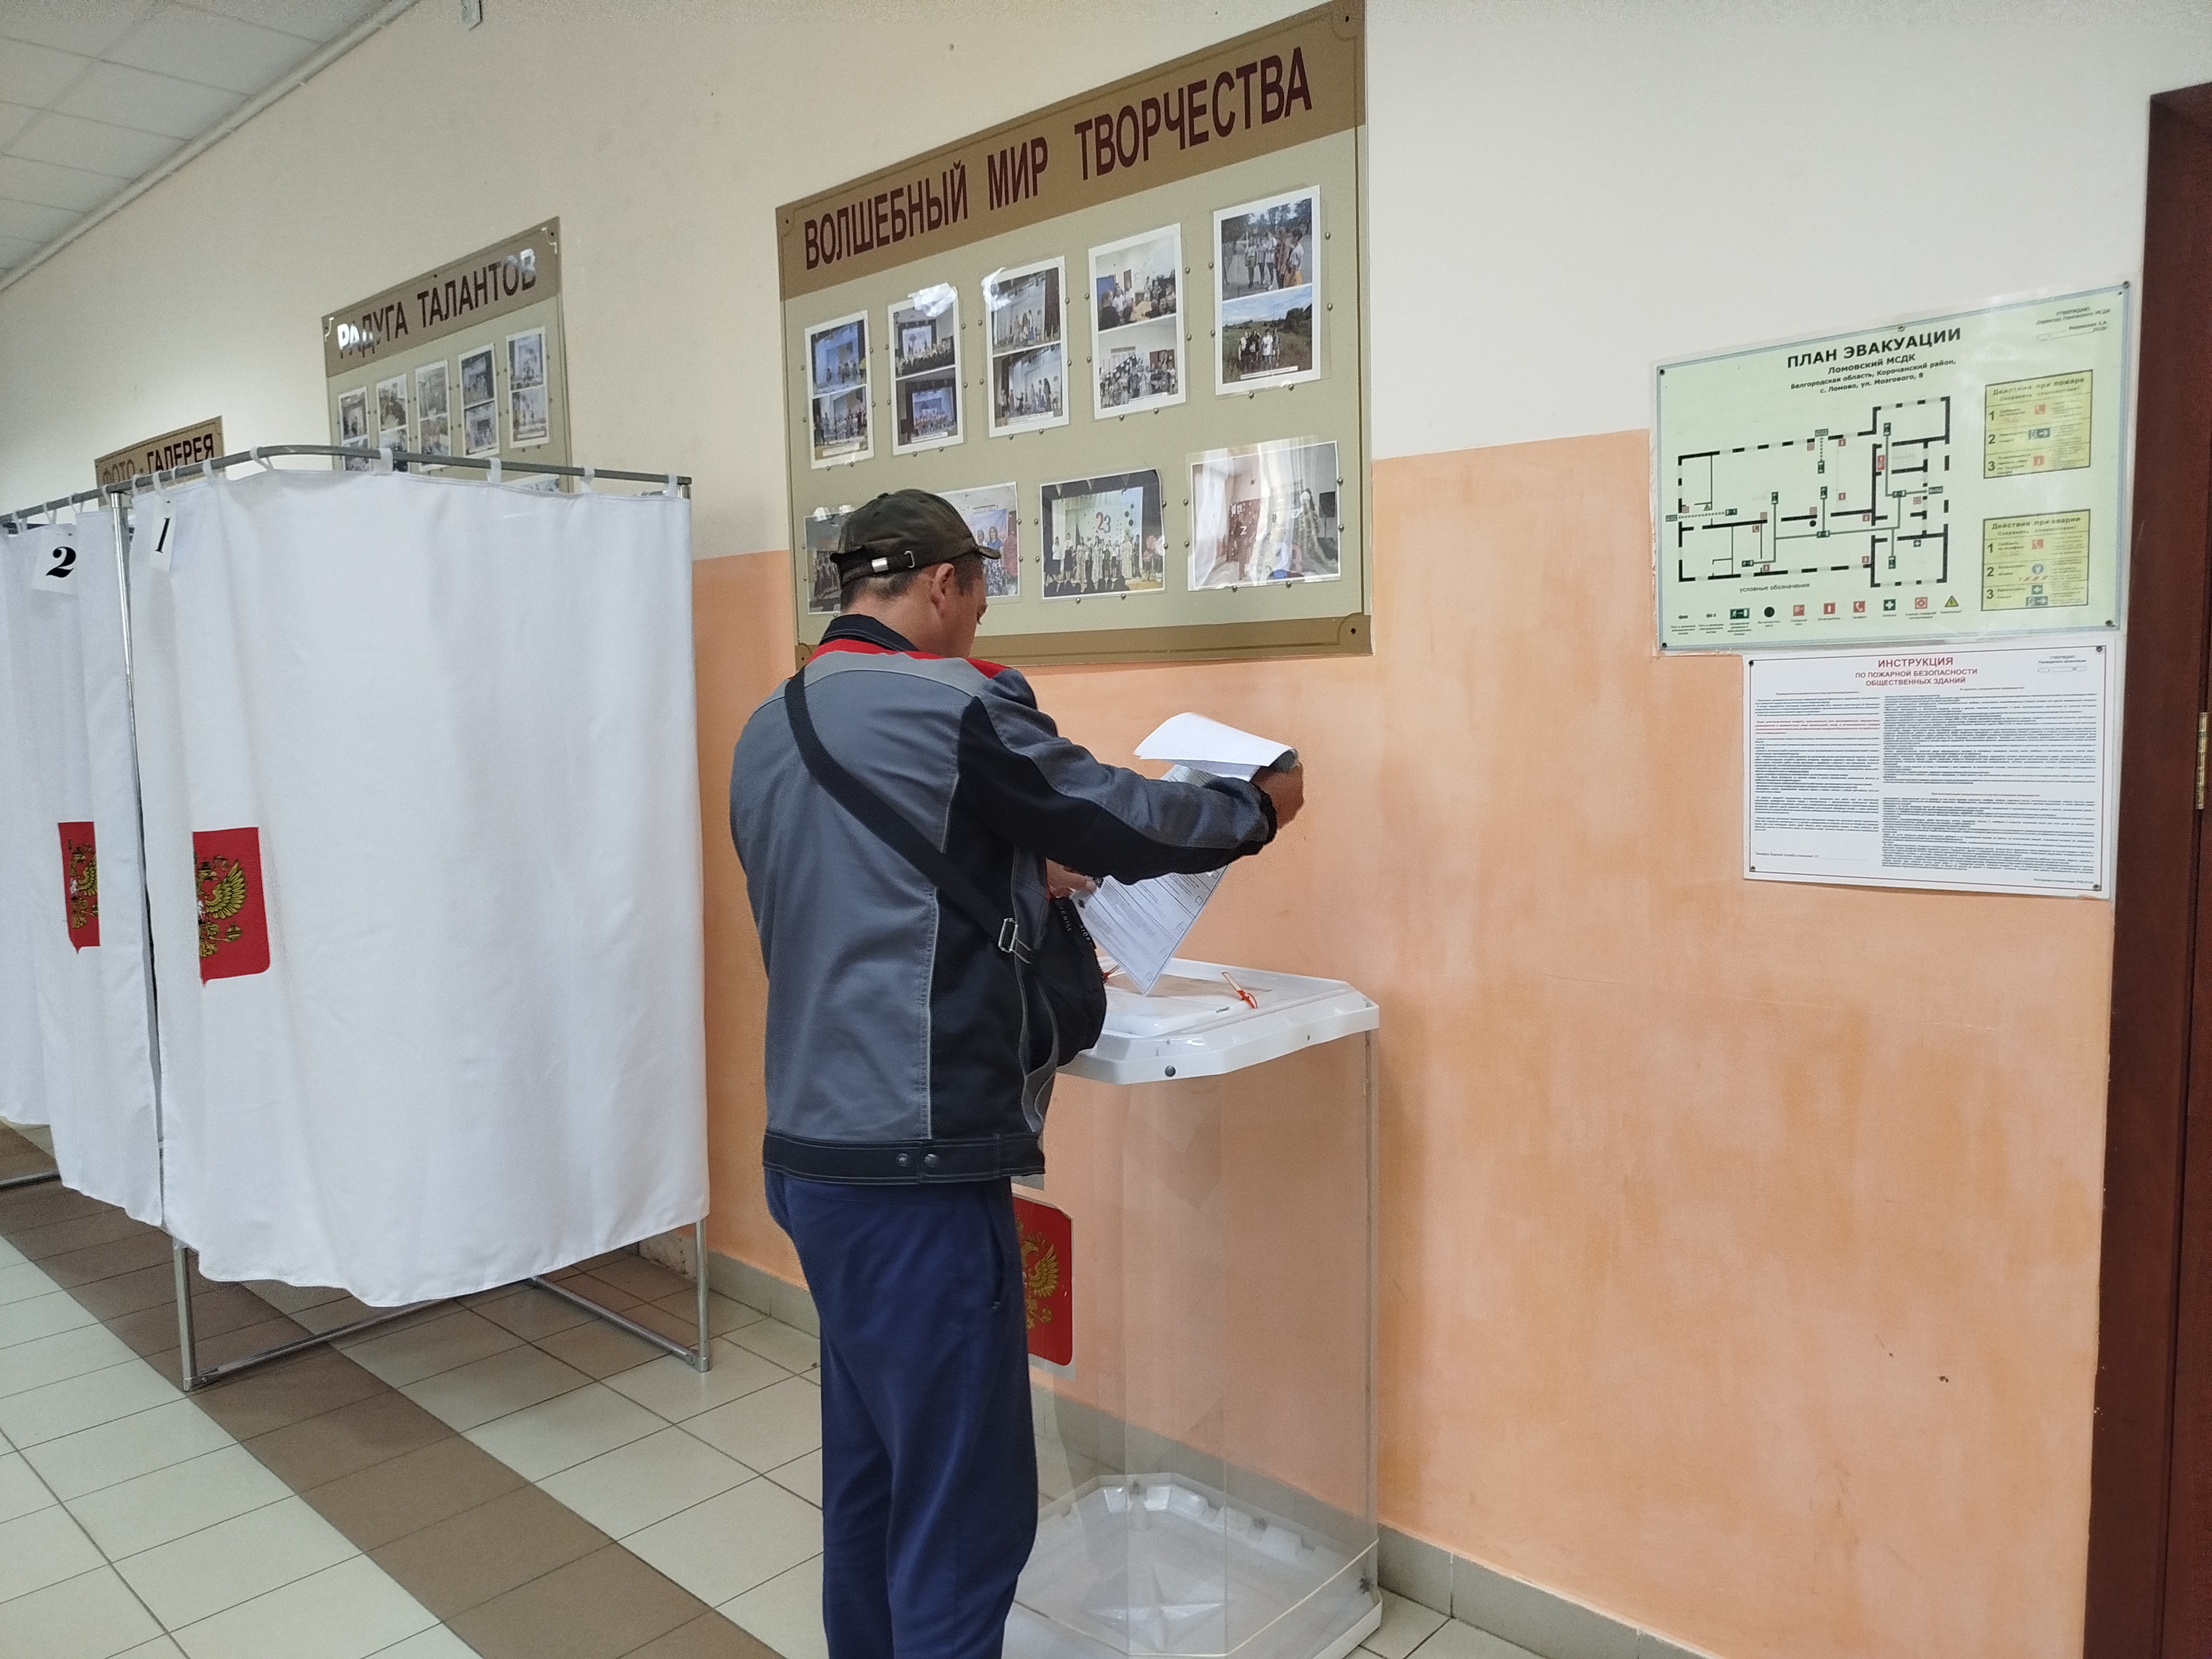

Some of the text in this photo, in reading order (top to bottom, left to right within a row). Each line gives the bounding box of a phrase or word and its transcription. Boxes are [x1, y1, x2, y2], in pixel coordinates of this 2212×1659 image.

[804, 47, 1313, 271] ВОЛШЕБНЫЙ МИР ТВОРЧЕСТВА
[417, 248, 537, 328] ТАЛАНТОВ
[1787, 327, 1961, 369] ПЛАН ЭВАКУАЦИИ
[1828, 353, 1916, 375] Ломовский МСДК
[1791, 358, 1957, 390] Белгородская область, Корочанский район,
[1828, 383, 1859, 394] Ломово,
[1861, 380, 1872, 388] ул.
[1874, 374, 1917, 385] Мозгового,
[2054, 378, 2084, 387] пожаре
[1989, 410, 1995, 421] 1
[1988, 434, 1996, 445] 2
[1988, 461, 1995, 471] 3
[1992, 521, 2030, 530] Действия
[1987, 543, 1993, 554] 1
[45, 546, 76, 578] 2
[1986, 567, 1994, 577] 2
[1740, 585, 1768, 593] условные
[1986, 589, 1994, 599] 3
[1878, 657, 1953, 667] ИНСТРУКЦИЯ
[1867, 670, 1911, 678] ПОЖАРНОЙ
[1865, 676, 1966, 686] ОБЩЕСТВЕННЫХ ЗДАНИЙ
